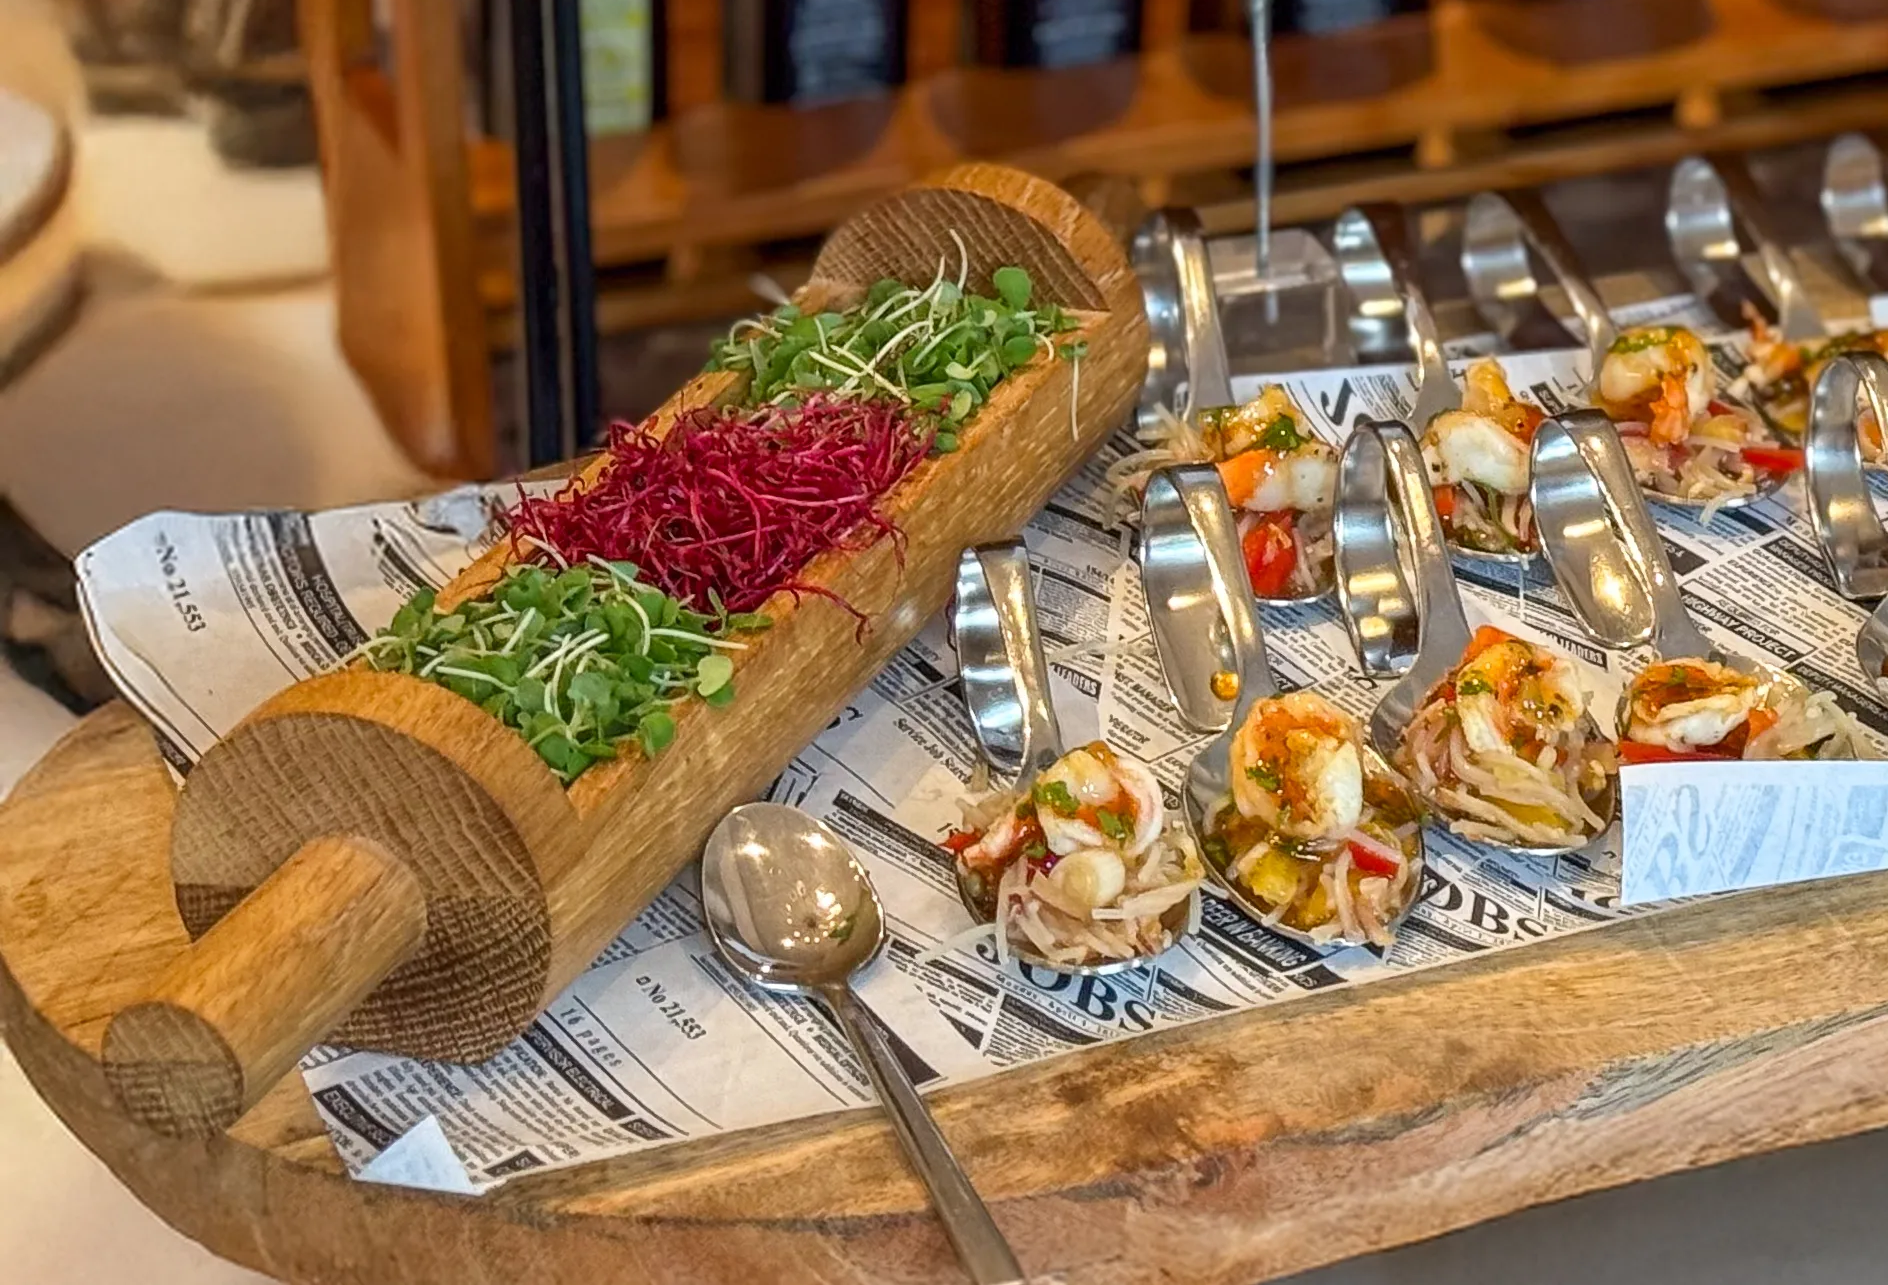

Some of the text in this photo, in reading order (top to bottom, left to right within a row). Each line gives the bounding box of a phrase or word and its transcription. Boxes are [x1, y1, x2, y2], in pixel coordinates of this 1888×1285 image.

[1682, 594, 1738, 629] HIGHWAY
[1734, 622, 1797, 659] PROJECT
[1421, 882, 1548, 942] OBS
